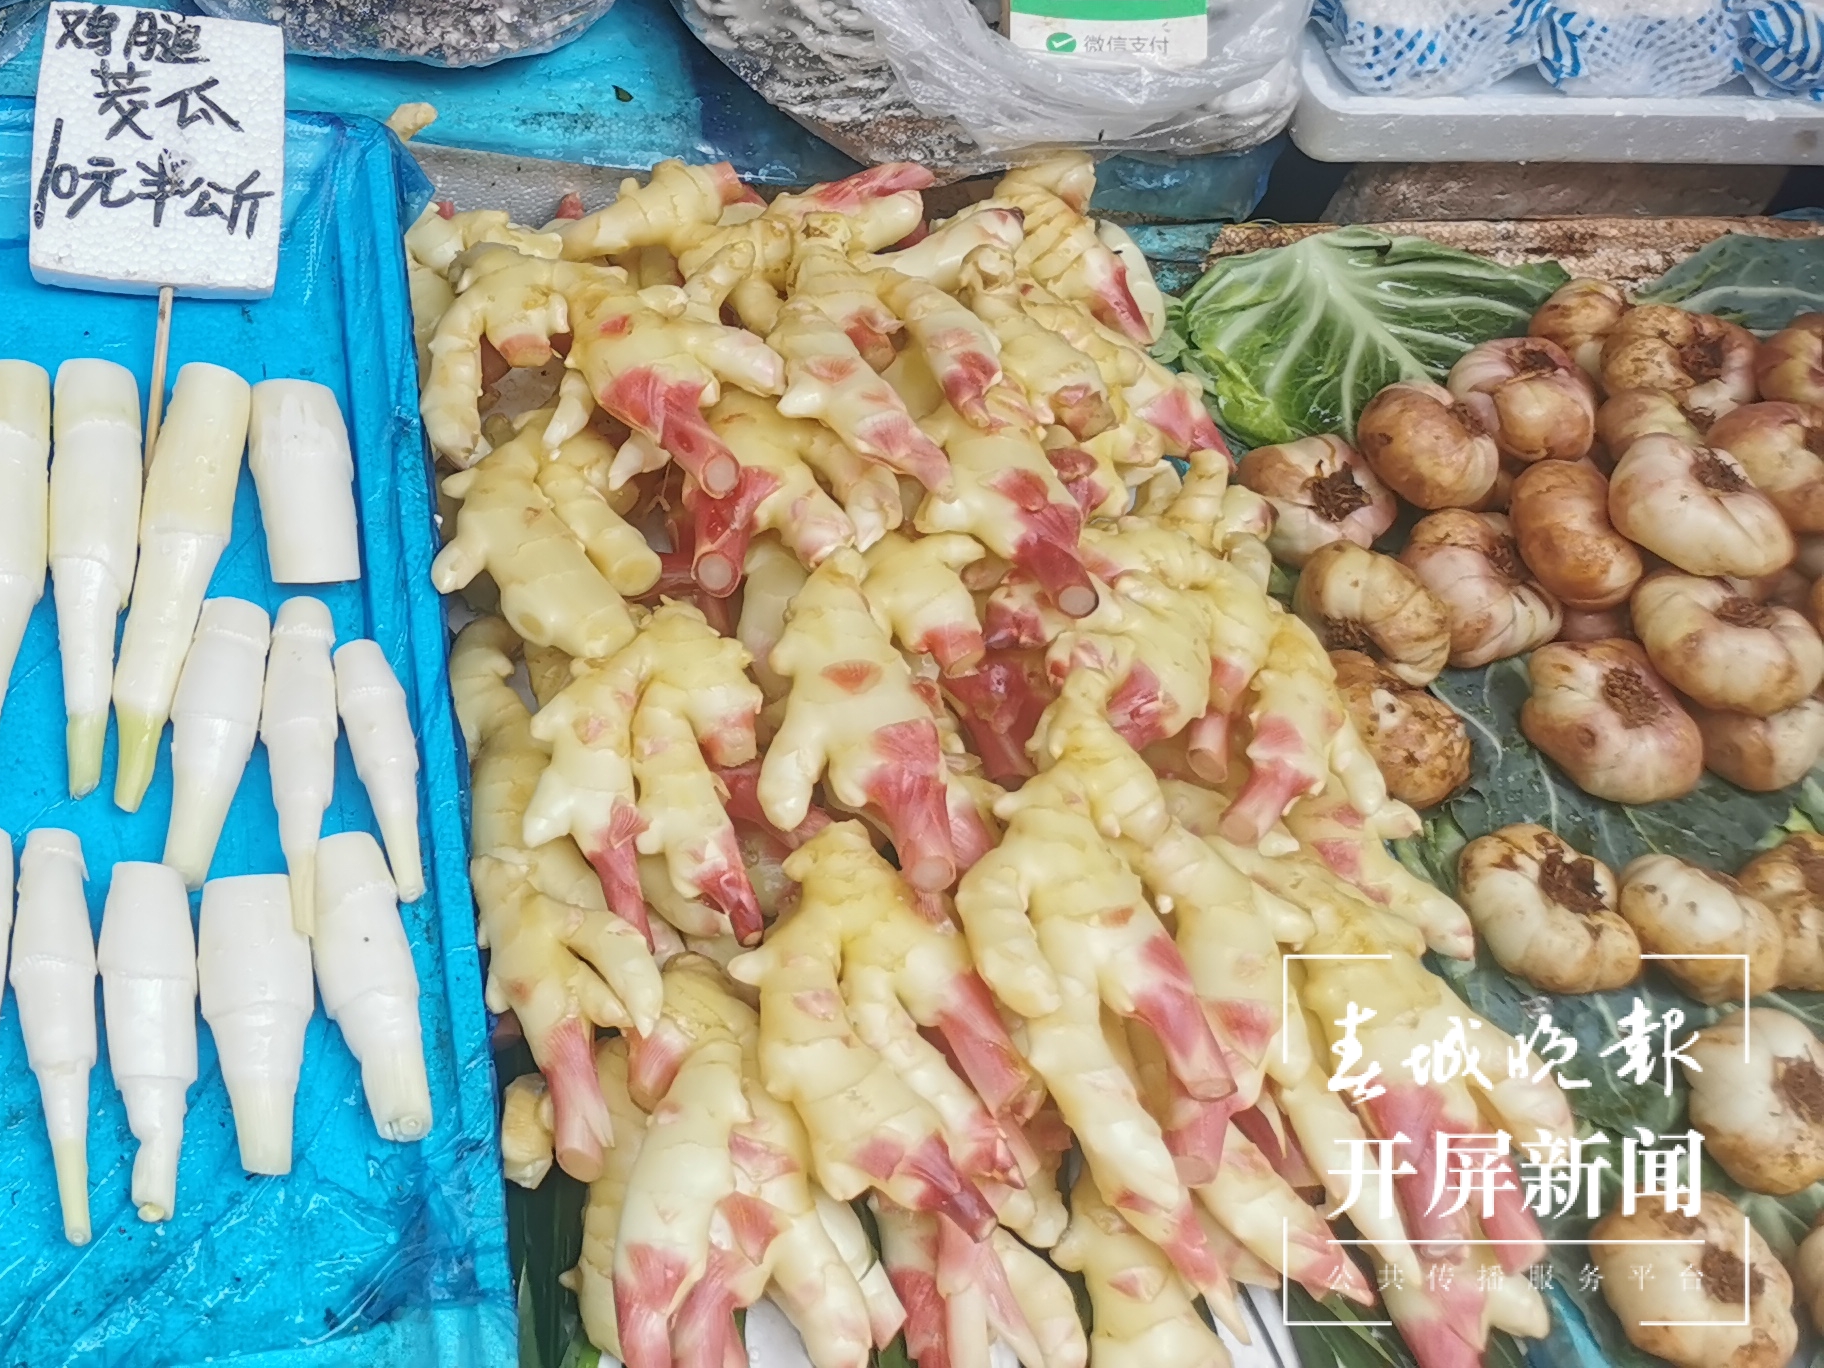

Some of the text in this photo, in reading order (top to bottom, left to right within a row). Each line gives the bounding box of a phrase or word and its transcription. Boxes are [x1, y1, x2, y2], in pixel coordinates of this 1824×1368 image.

[55, 5, 210, 64] 鸡腿
[1084, 35, 1169, 54] 微信支付
[33, 117, 275, 239] 10元半公斤
